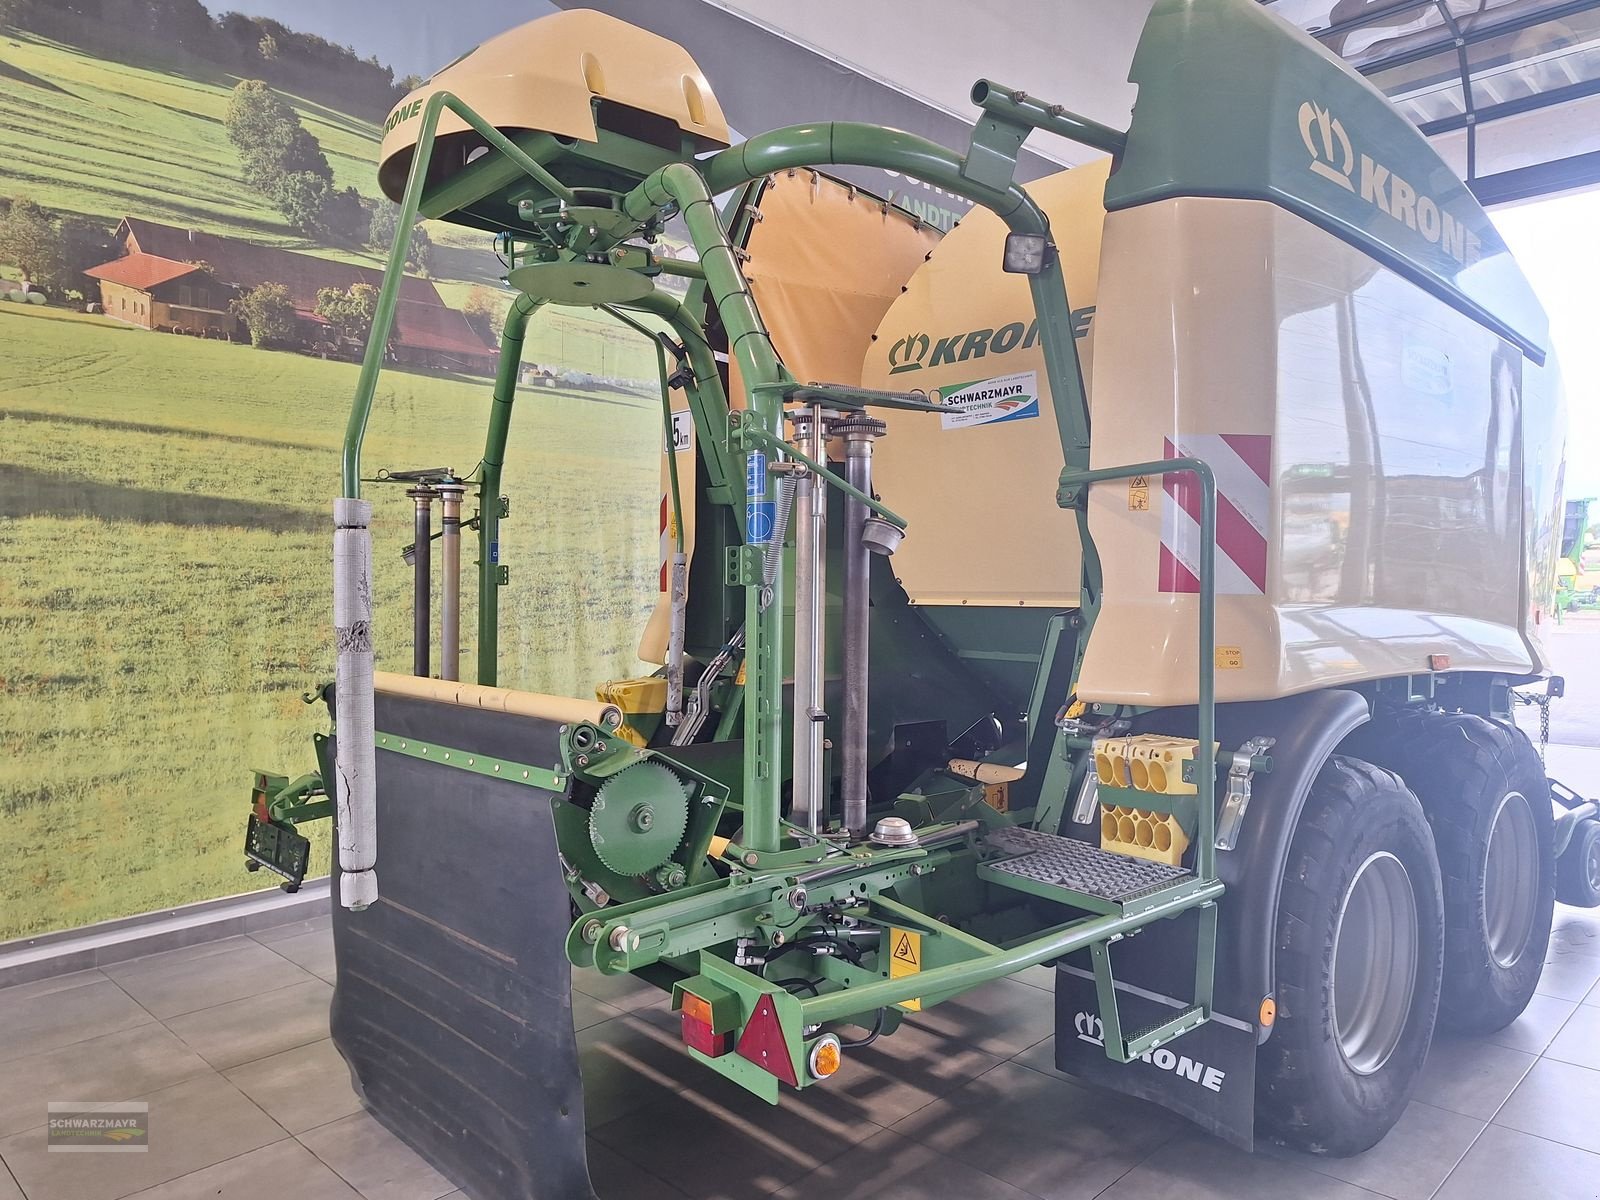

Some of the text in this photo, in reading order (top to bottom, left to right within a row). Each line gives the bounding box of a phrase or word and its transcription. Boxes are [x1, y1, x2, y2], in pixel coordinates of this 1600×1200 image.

[382, 98, 424, 142] RONE
[1360, 153, 1482, 270] KRONE
[947, 385, 1023, 406] SCHWARZMAYR
[962, 402, 993, 412] TECHNIK
[673, 416, 680, 447] 5
[1138, 1048, 1225, 1092] ONE
